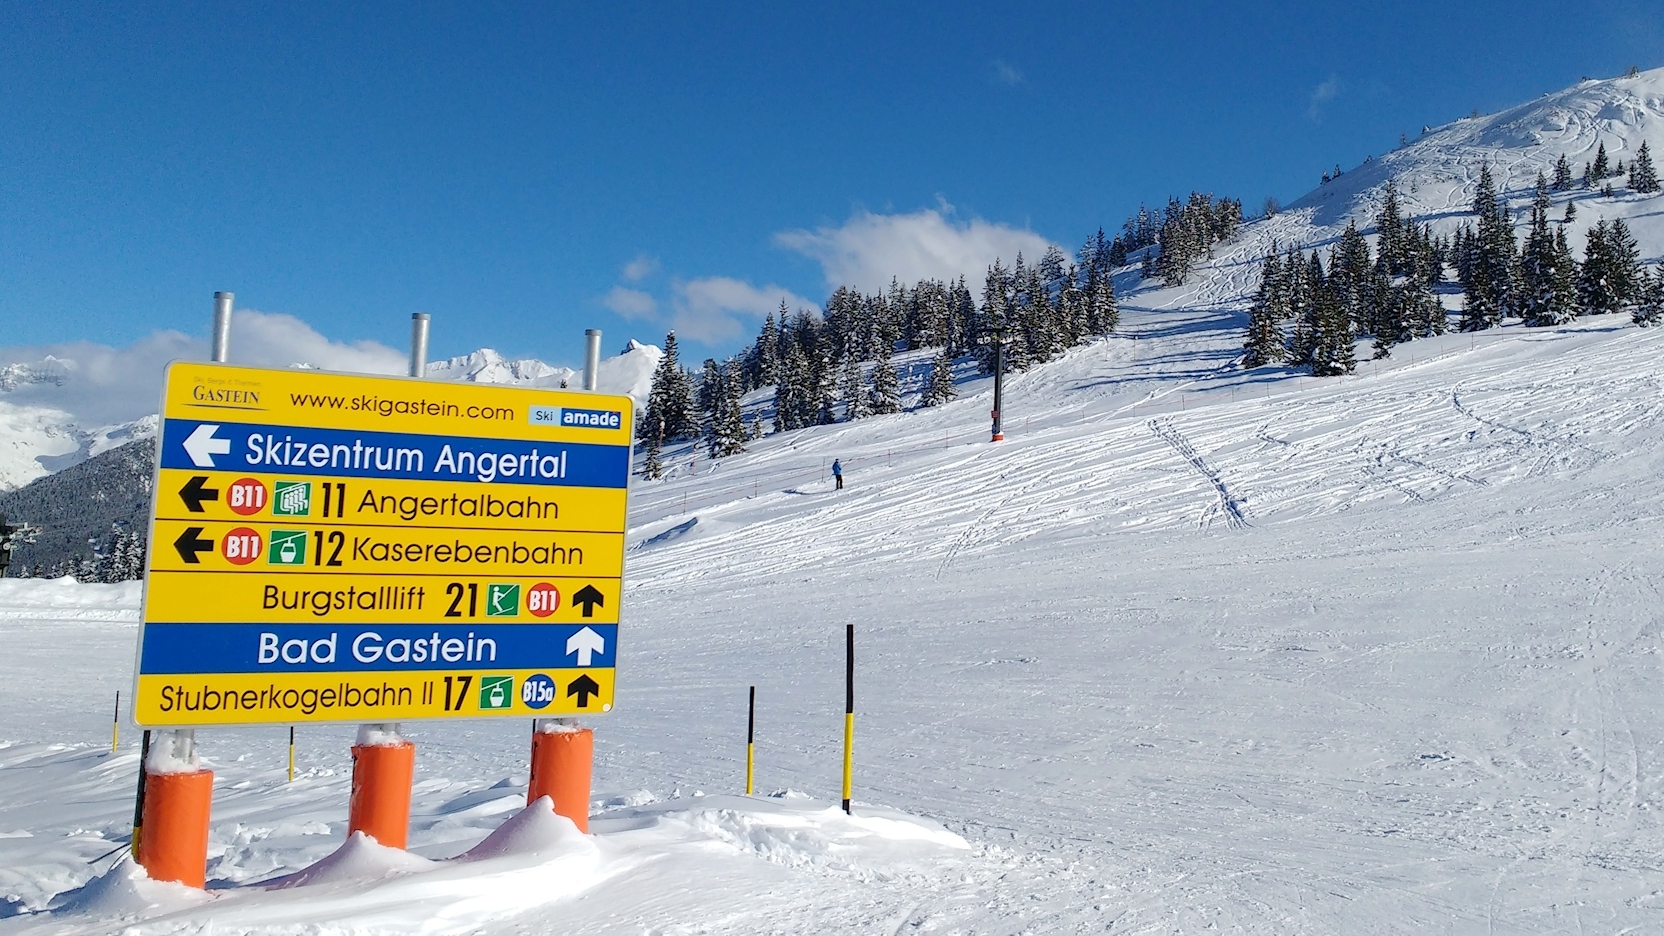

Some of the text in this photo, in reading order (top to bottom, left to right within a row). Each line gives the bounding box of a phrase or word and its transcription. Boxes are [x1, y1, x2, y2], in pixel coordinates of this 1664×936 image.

[193, 385, 260, 404] GASTEIN
[290, 393, 515, 421] www.skigastein.com
[536, 410, 553, 421] Ski
[245, 433, 568, 483] Skizentrum Angertal
[231, 482, 559, 521] B11 11 Angertalbahn
[226, 531, 583, 567] B11 12 Kaserebenbahn
[262, 583, 557, 618] Burgstalllift 21 B11
[258, 632, 497, 664] Bad Gastein
[160, 682, 412, 715] Stubnerkogelbahn
[444, 676, 473, 711] 17
[523, 681, 554, 703] B15a
